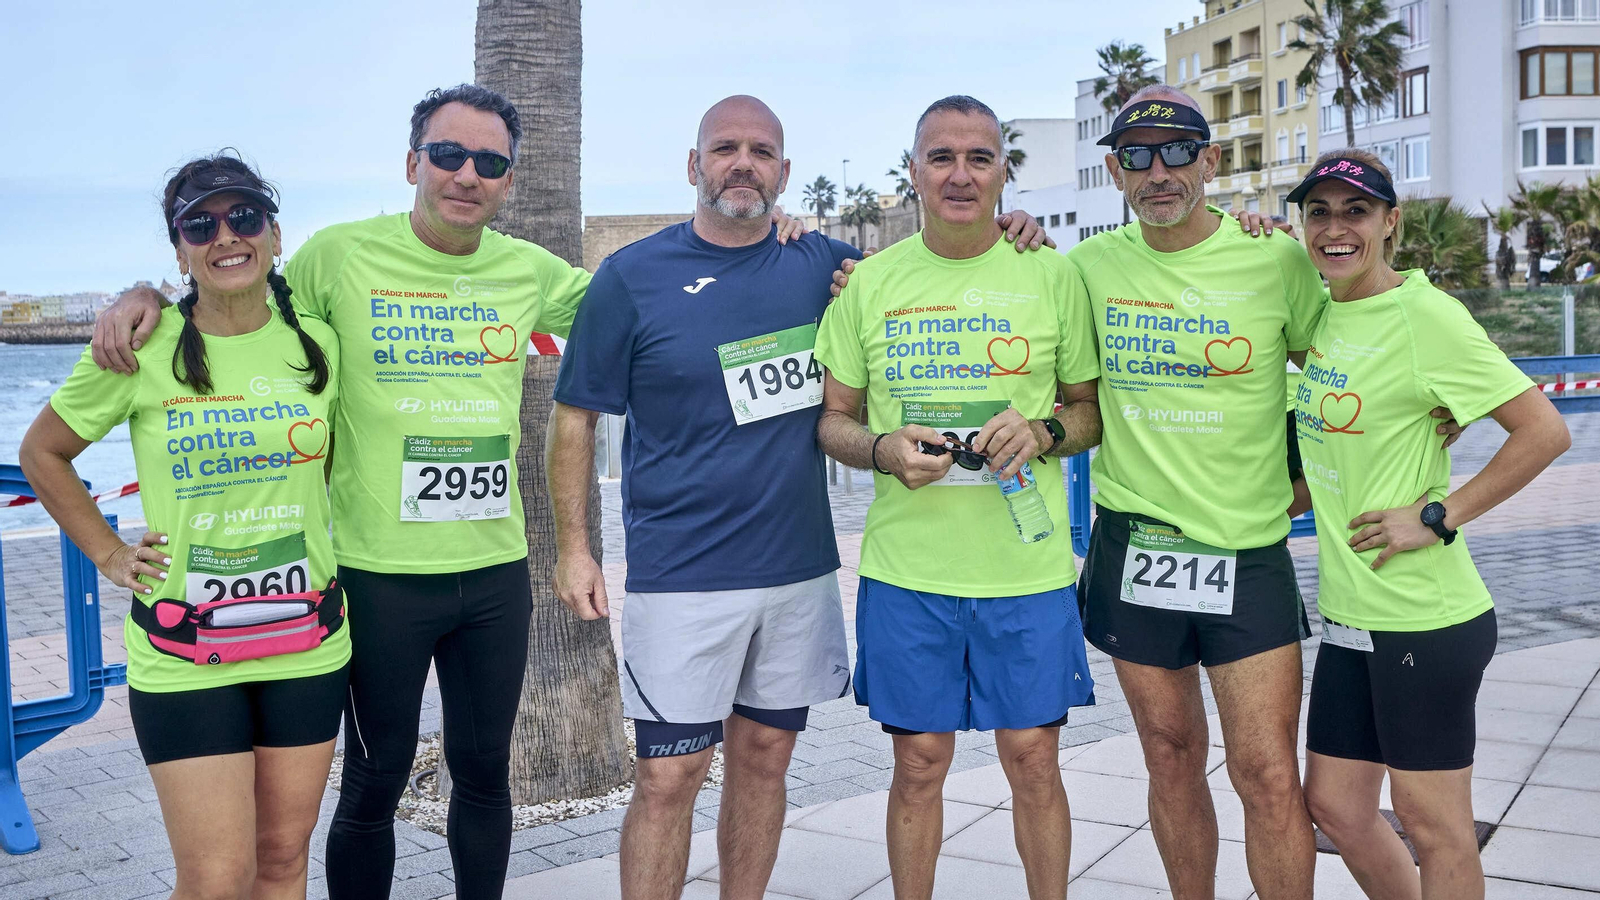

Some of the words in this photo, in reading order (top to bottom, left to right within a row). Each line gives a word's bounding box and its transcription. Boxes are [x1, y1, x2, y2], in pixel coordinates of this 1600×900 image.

[380, 288, 402, 297] CÁDIZ
[371, 298, 402, 318] En
[410, 302, 499, 322] marcha
[893, 308, 913, 316] CÁDIZ
[1114, 298, 1133, 306] CÁDIZ
[1145, 301, 1174, 309] MARCHA
[885, 320, 911, 338] En
[919, 313, 1011, 333] marcha
[1106, 307, 1129, 327] En
[1136, 314, 1230, 334] marcha
[372, 324, 454, 343] contra
[1106, 333, 1176, 354] contra
[721, 343, 740, 353] Cádiz
[752, 335, 777, 346] marcha
[725, 350, 746, 360] contra
[756, 342, 778, 352] cáncer
[887, 338, 960, 358] contra
[374, 344, 398, 364] el
[404, 345, 488, 366] cáncer
[739, 352, 822, 400] 1984
[885, 361, 904, 381] el
[910, 359, 995, 379] cáncer
[1106, 354, 1121, 372] el
[1127, 356, 1212, 378] cáncer
[1304, 363, 1348, 389] marcha
[1129, 379, 1154, 387] ESPAÑOLA
[170, 395, 194, 405] CÁDIZ
[430, 400, 499, 412] HYUNDAI
[167, 408, 194, 431] En
[203, 401, 310, 424] marcha
[1149, 409, 1223, 422] HYUNDAI
[1296, 404, 1325, 433] áncer
[1149, 424, 1194, 433] Guadalete
[1196, 426, 1223, 434] Motor
[167, 428, 256, 455] contra
[445, 438, 472, 446] marcha
[172, 457, 193, 480] el
[200, 451, 296, 476] cáncer
[202, 481, 231, 490] ESPAÑOLA
[233, 478, 256, 486] CONTRA
[418, 464, 507, 500] 2959
[224, 505, 304, 523] HYUNDAI
[224, 522, 277, 535] Guadalete
[192, 547, 213, 556] Cádiz
[226, 548, 258, 558] marcha
[194, 555, 219, 565] contra
[220, 557, 228, 565] el
[230, 556, 259, 565] cáncer
[1132, 552, 1228, 593] 2214
[204, 565, 306, 602] 2960
[673, 731, 713, 755] RUN
